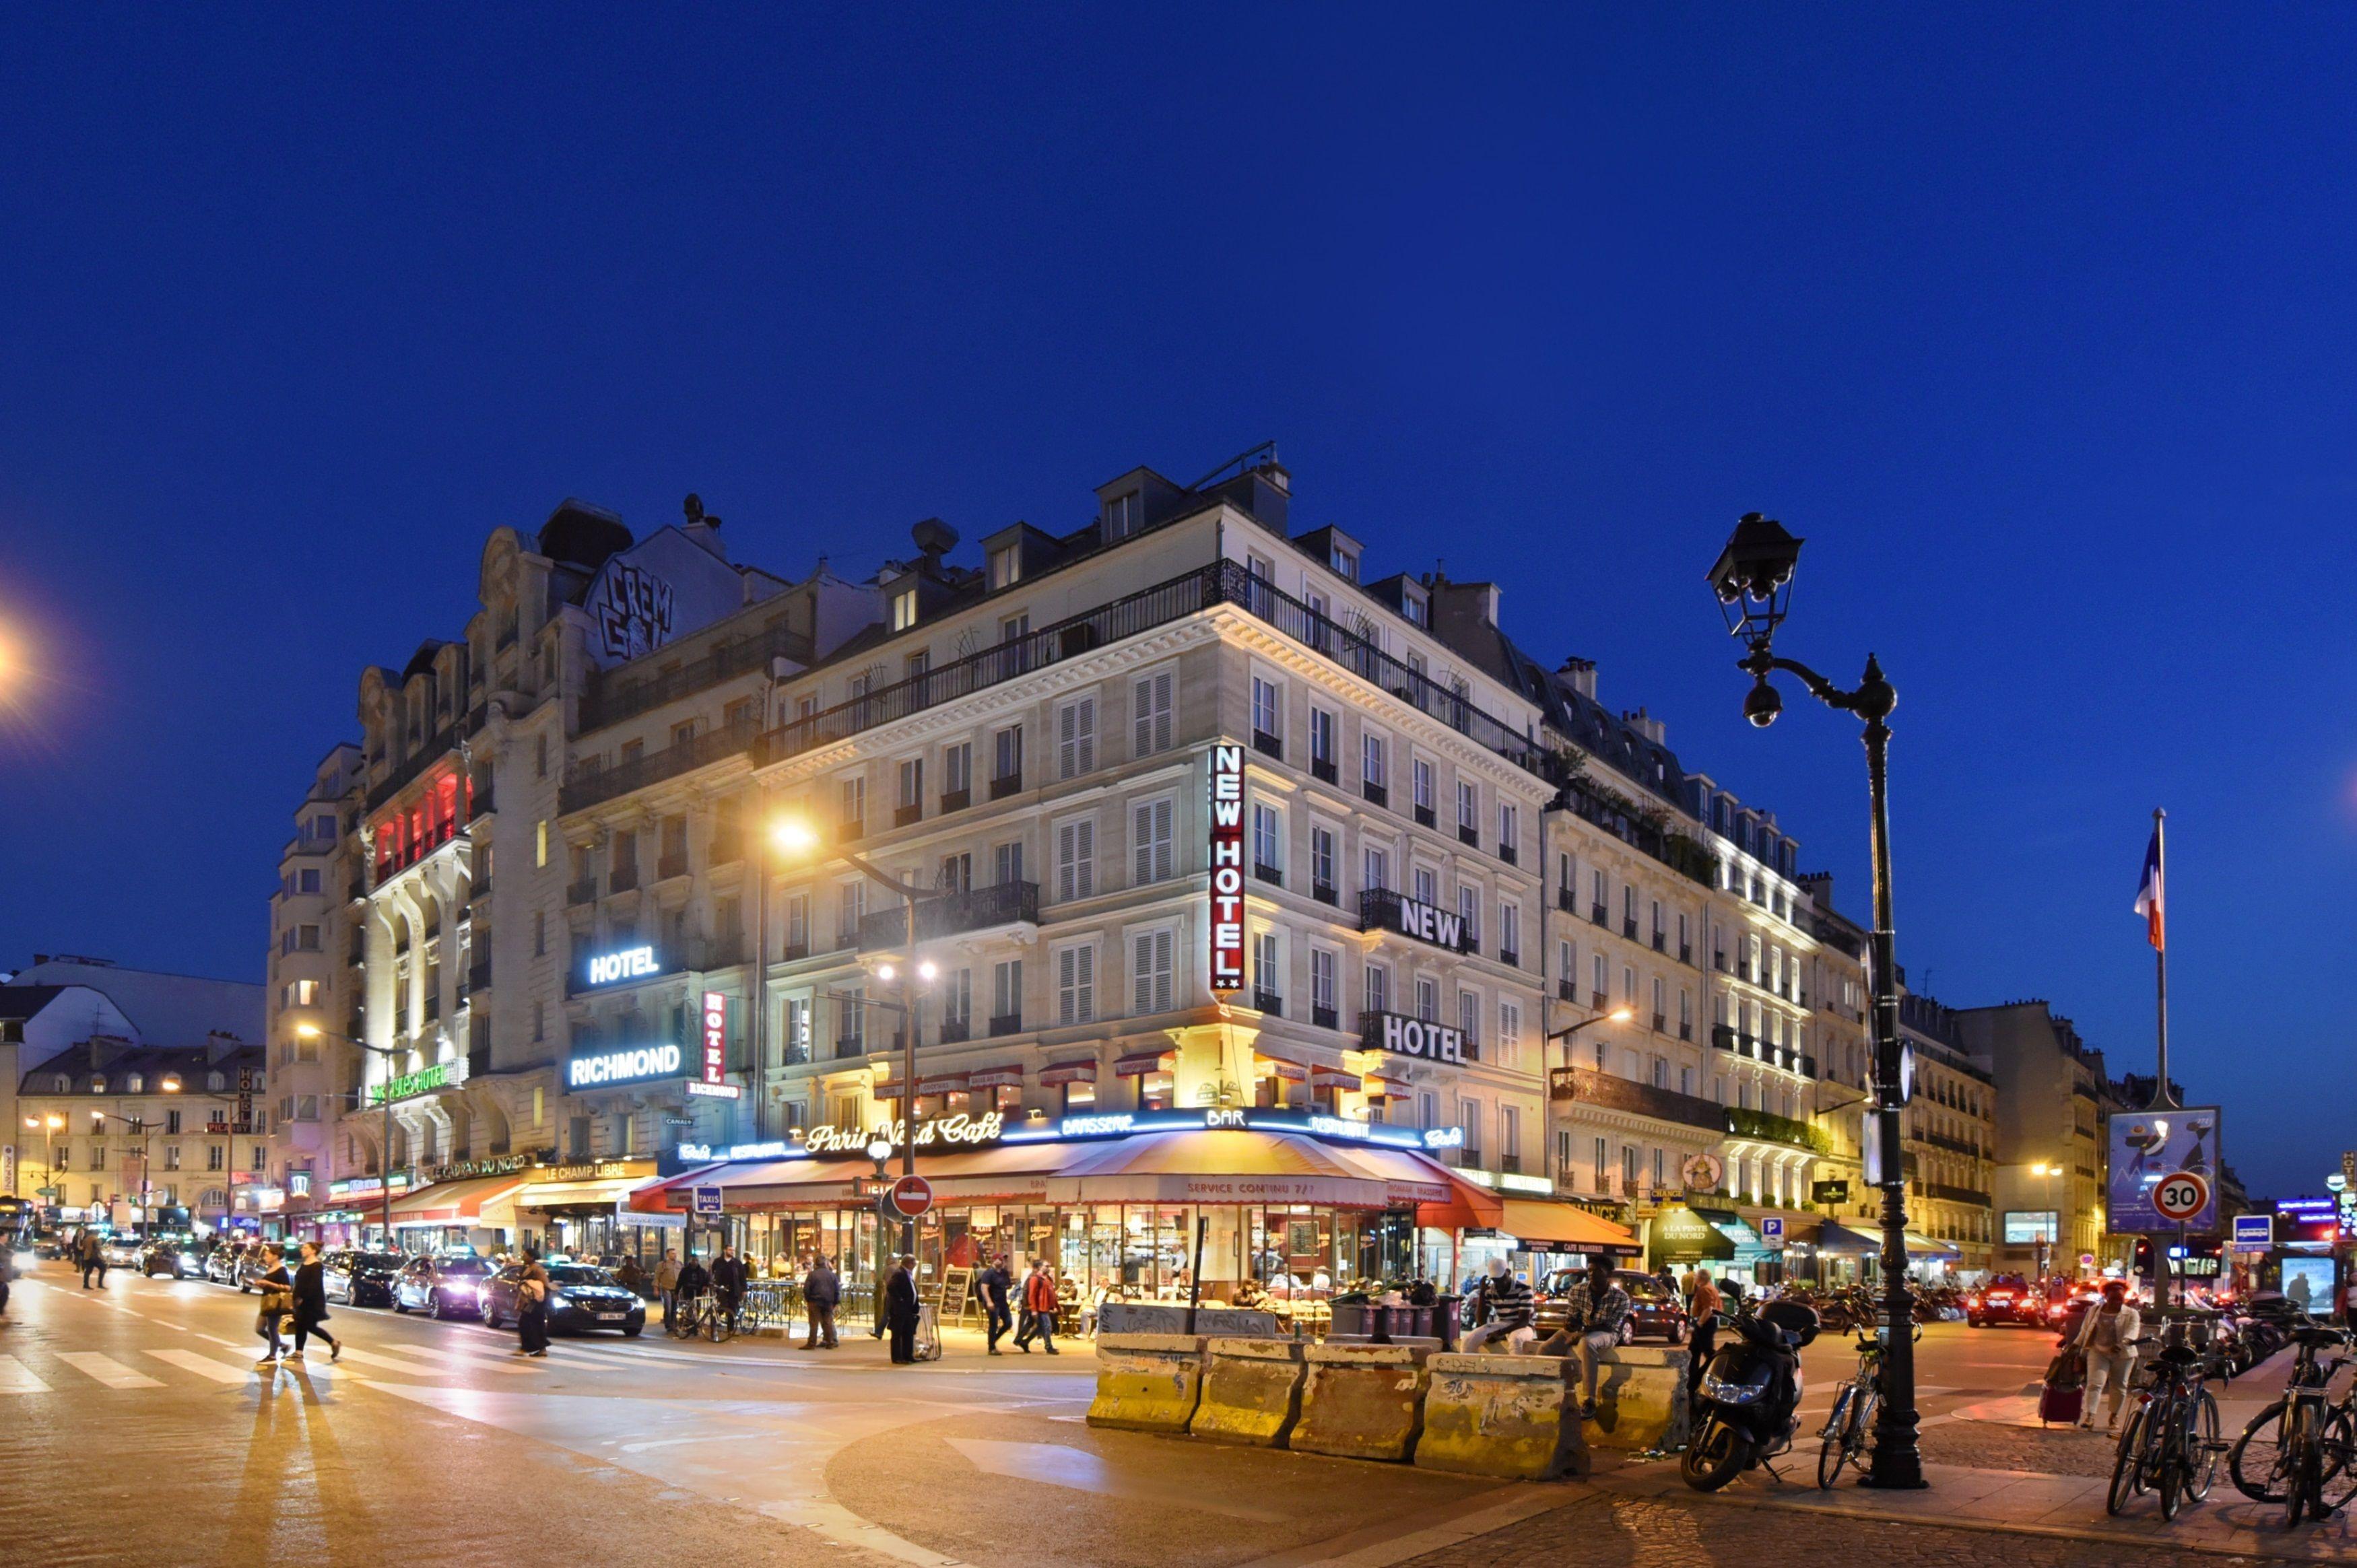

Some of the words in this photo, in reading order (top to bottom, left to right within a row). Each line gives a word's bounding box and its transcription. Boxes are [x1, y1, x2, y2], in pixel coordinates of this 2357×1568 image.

[1214, 746, 1241, 826] NEW
[1216, 841, 1240, 976] HOTEL
[1401, 897, 1460, 947] NEW
[590, 946, 659, 984] HOTEL
[706, 993, 723, 1083] HOTEL
[1383, 1015, 1467, 1065] HOTEL
[571, 1045, 680, 1085] RICHMOND
[240, 1068, 251, 1122] HOTEL
[688, 1082, 739, 1098] RICHMOND
[209, 1124, 248, 1132] PICADY
[1062, 1115, 1134, 1136] BRASSERIE
[1207, 1110, 1246, 1126] BAR
[805, 1125, 867, 1152] Paris
[937, 1112, 1003, 1144] Café
[1425, 1127, 1462, 1146] Café
[442, 1162, 479, 1179] CADRAN
[482, 1159, 494, 1173] DU
[498, 1155, 525, 1174] NORD
[546, 1168, 556, 1180] LE
[558, 1166, 593, 1180] CHAMP
[595, 1163, 626, 1177] LIBRE
[699, 1194, 719, 1204] TAXIS
[1188, 1183, 1233, 1193] SERVICE
[1238, 1184, 1290, 1194] CONTINU
[1651, 1190, 1683, 1198] CHANGE
[2164, 1187, 2196, 1206] 30
[1767, 1221, 1777, 1233] P
